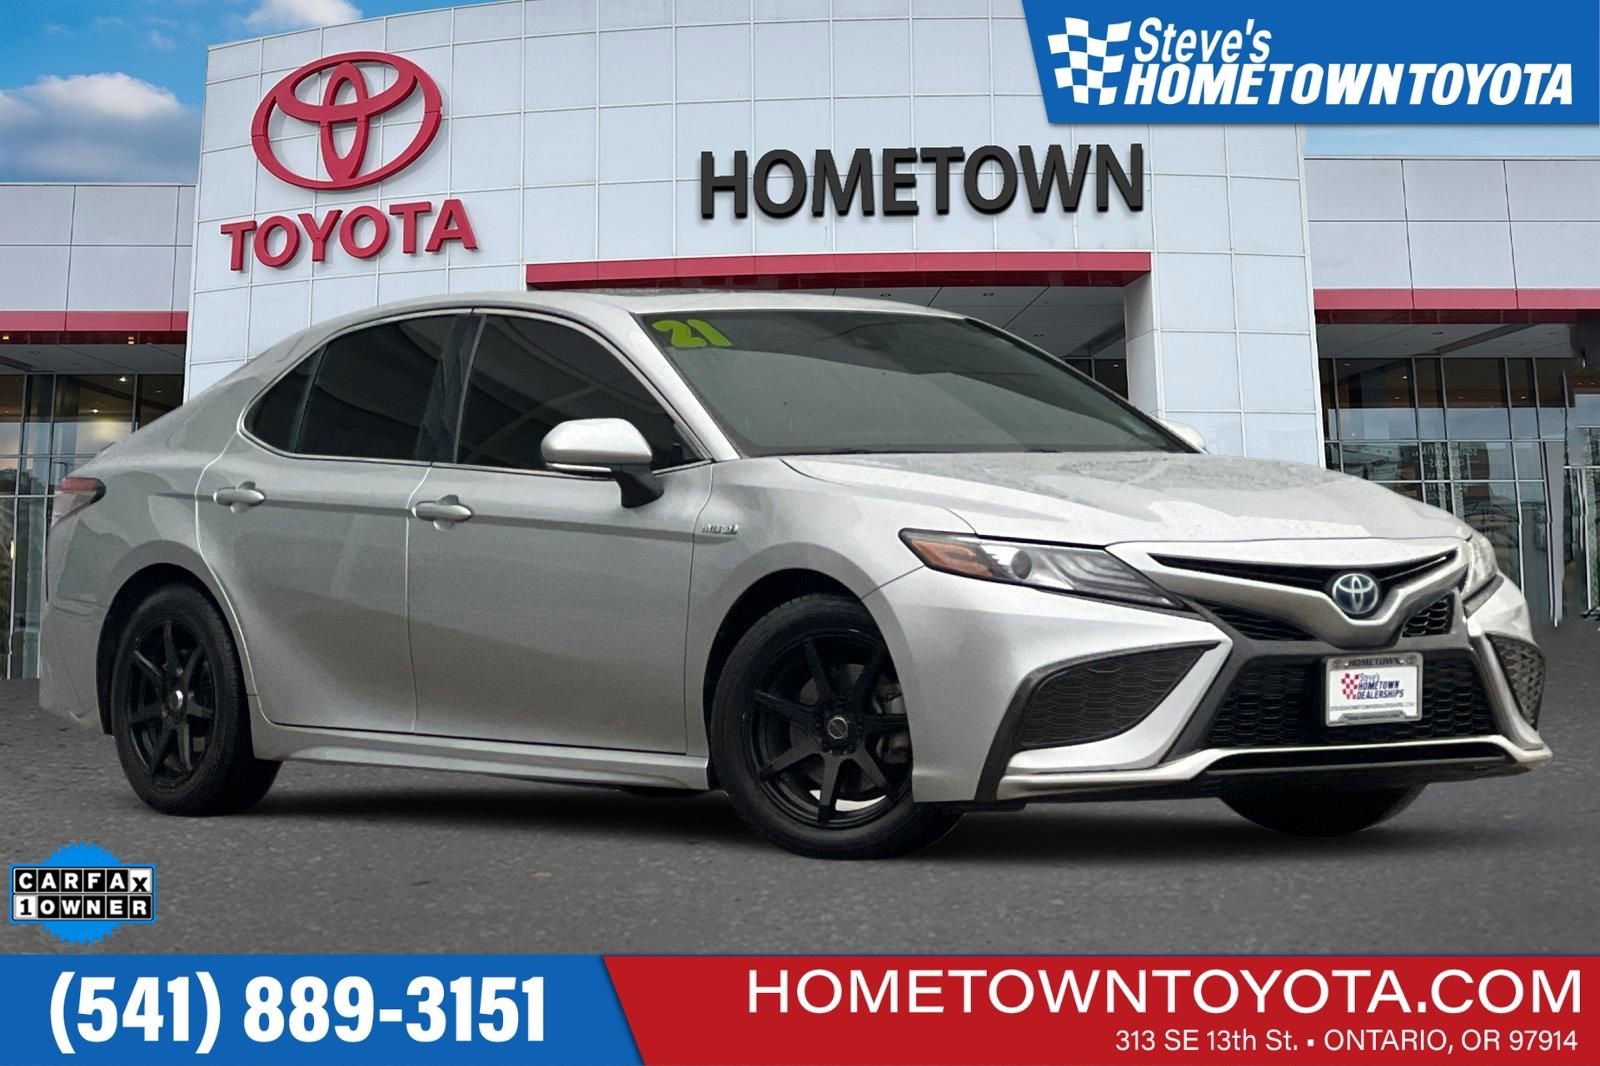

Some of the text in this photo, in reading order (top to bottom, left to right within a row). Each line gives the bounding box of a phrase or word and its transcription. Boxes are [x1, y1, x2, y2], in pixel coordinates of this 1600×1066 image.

[700, 143, 1145, 220] HOMETOWN
[220, 198, 479, 272] TOYOTA
[652, 319, 733, 348] 21
[1356, 689, 1404, 700] DEALERSHIPS
[1358, 680, 1400, 690] HOMETOWN
